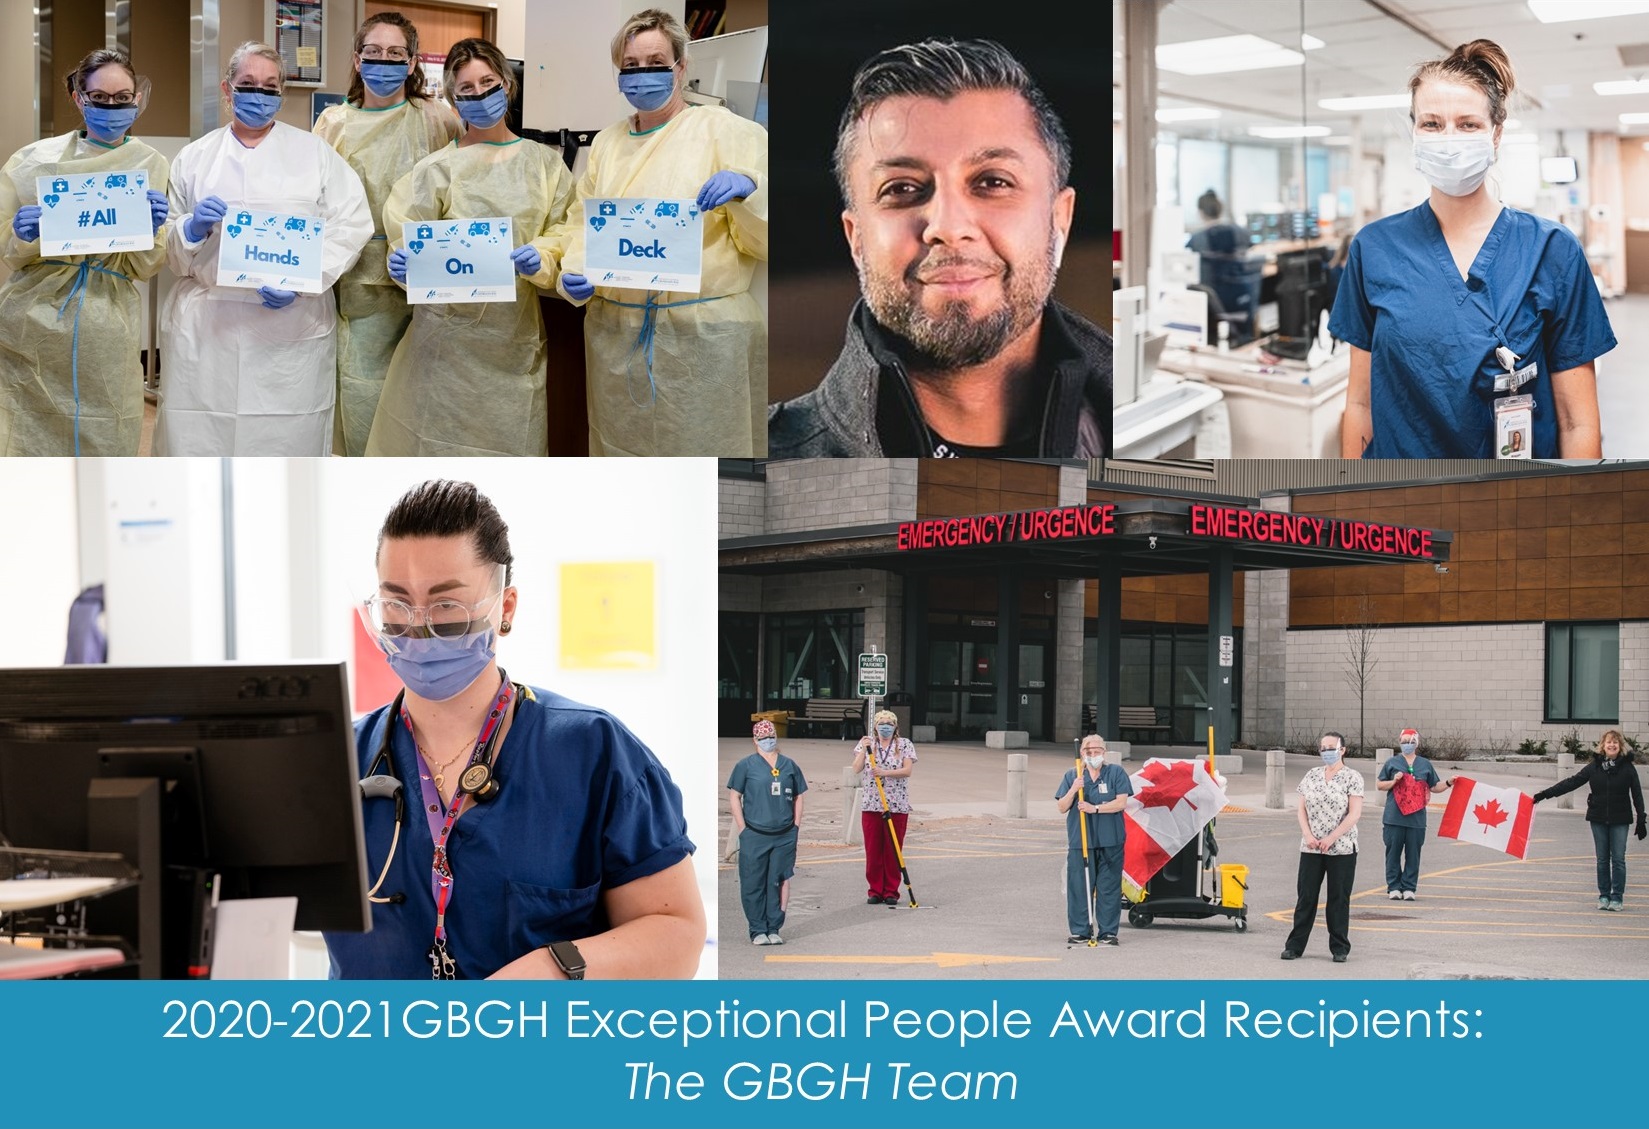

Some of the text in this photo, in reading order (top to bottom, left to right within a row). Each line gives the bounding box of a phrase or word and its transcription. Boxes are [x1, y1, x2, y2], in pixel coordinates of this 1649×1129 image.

[78, 208, 117, 227] #All
[245, 244, 300, 266] Hands
[619, 238, 667, 259] Deck
[445, 258, 474, 275] On
[897, 513, 1007, 551] EMERGENCY
[1019, 504, 1117, 541] URGENCE
[1191, 505, 1325, 546] EMERGENCY
[1339, 522, 1434, 558] URGENCE
